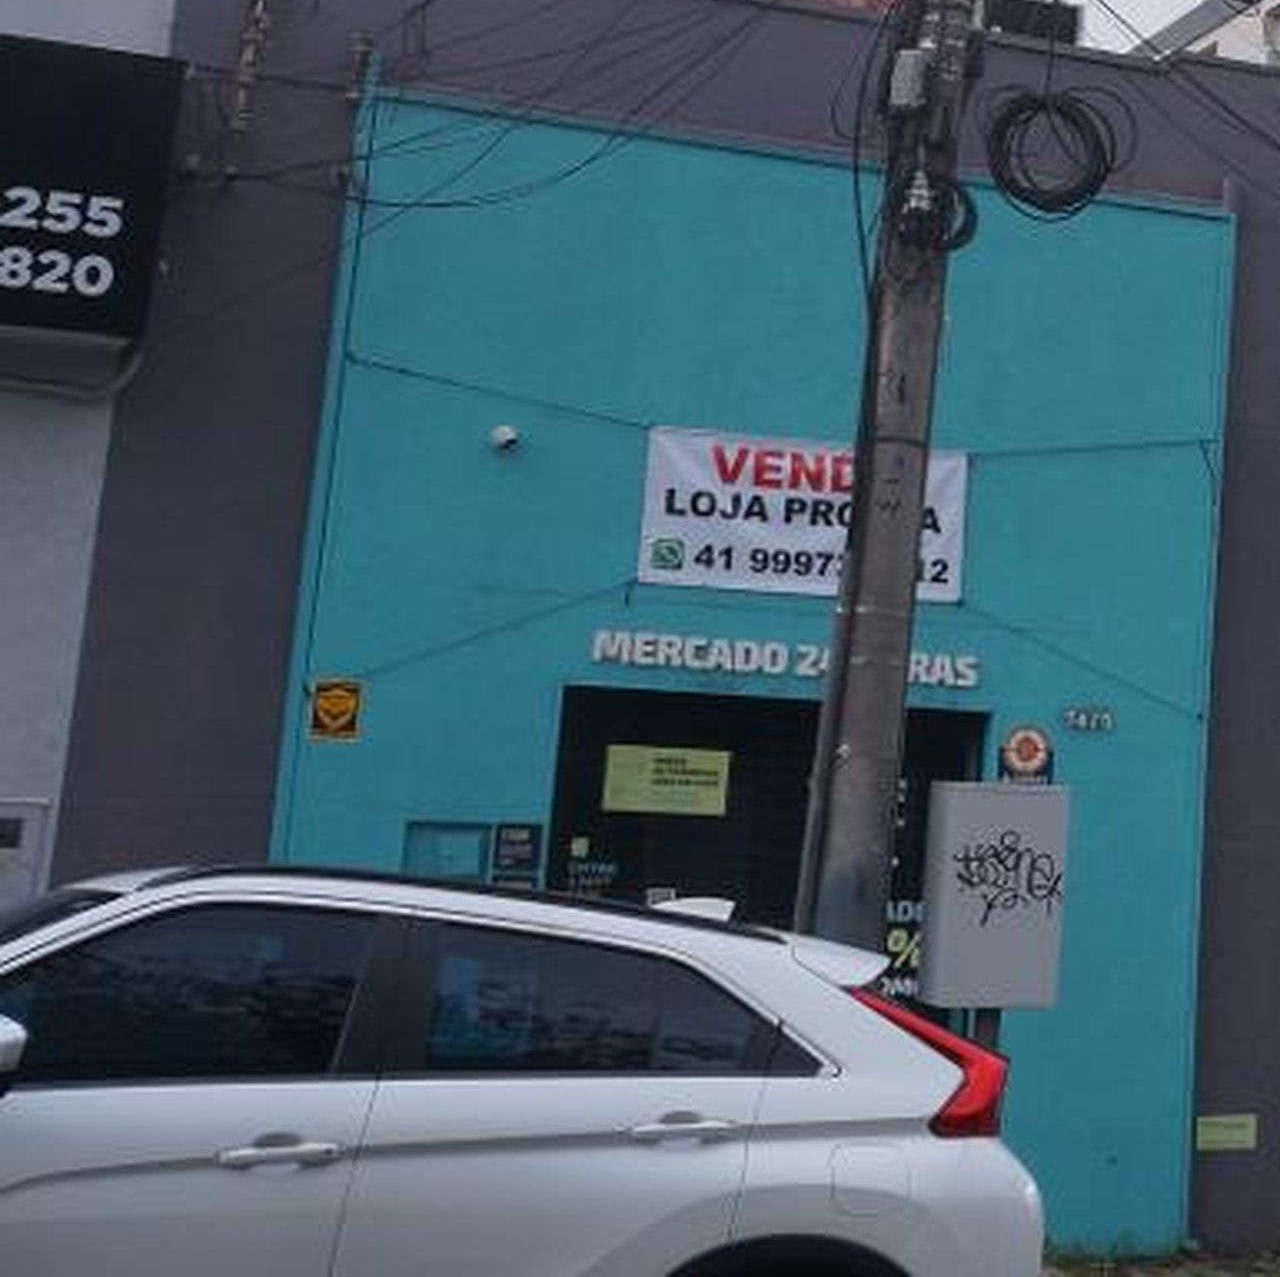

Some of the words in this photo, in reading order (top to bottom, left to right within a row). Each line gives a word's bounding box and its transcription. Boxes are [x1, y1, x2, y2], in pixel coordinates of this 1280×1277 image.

[0, 185, 125, 238] 255
[664, 488, 769, 523] LOJA
[693, 544, 734, 572] 41
[592, 629, 789, 676] MERCADO
